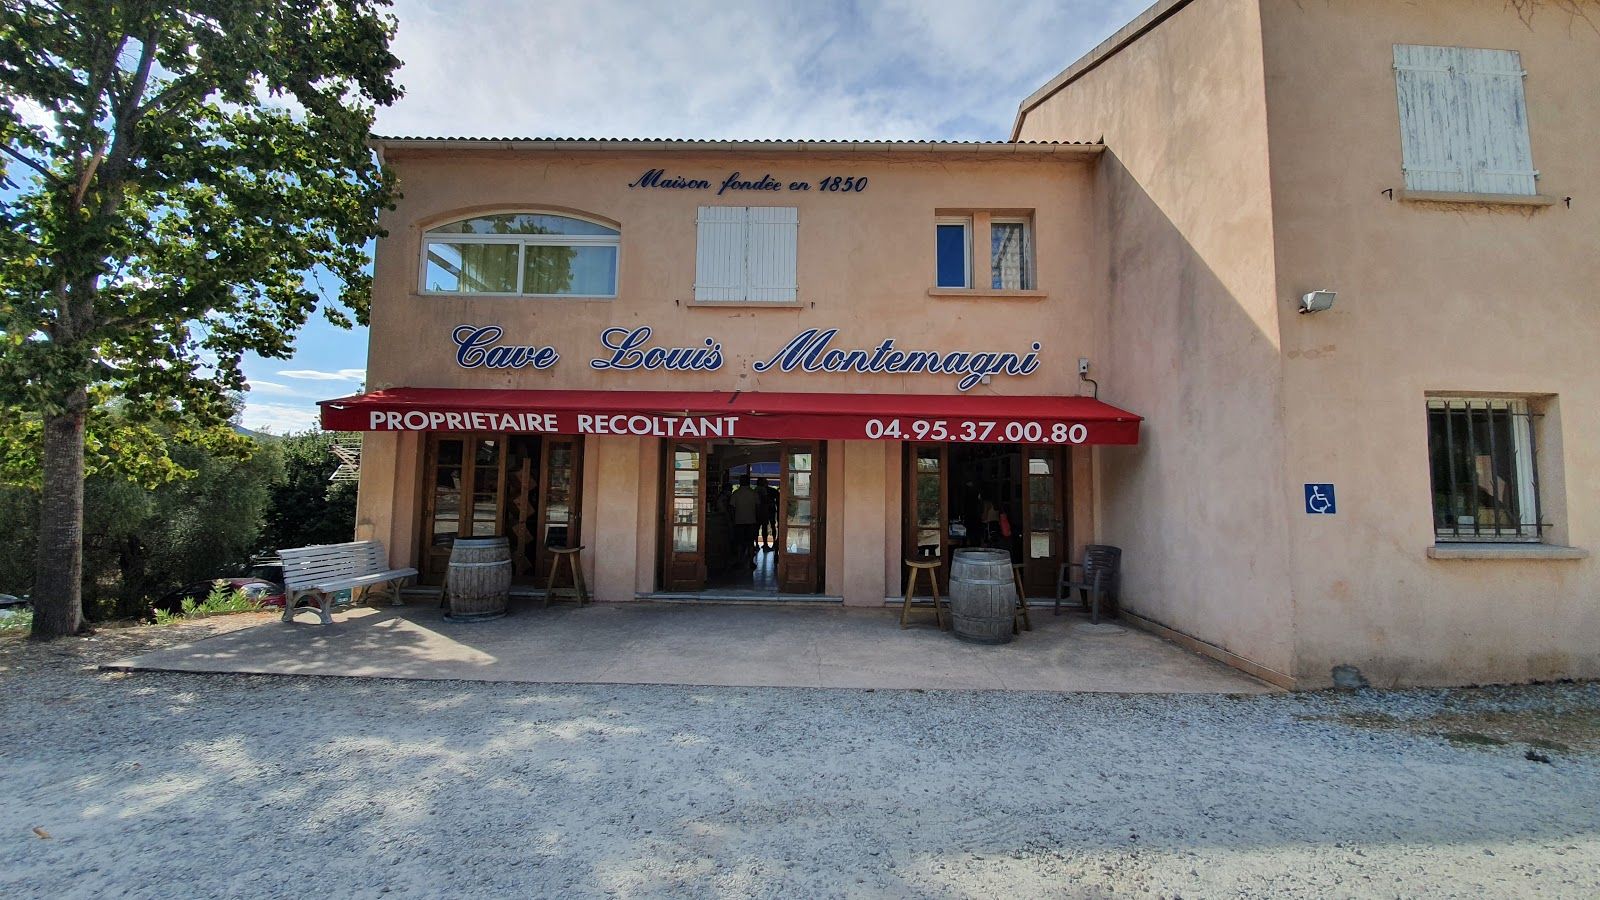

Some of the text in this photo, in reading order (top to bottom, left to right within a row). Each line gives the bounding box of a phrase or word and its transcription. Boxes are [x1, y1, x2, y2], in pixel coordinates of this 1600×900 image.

[628, 168, 711, 190] Maison
[788, 180, 811, 191] en
[819, 176, 868, 193] 1850
[451, 324, 1042, 392] Cave Louis Montemagni
[369, 410, 739, 437] PROPRIETAIRE RECOLTANT
[865, 418, 1088, 444] 04.95.37.00.80
